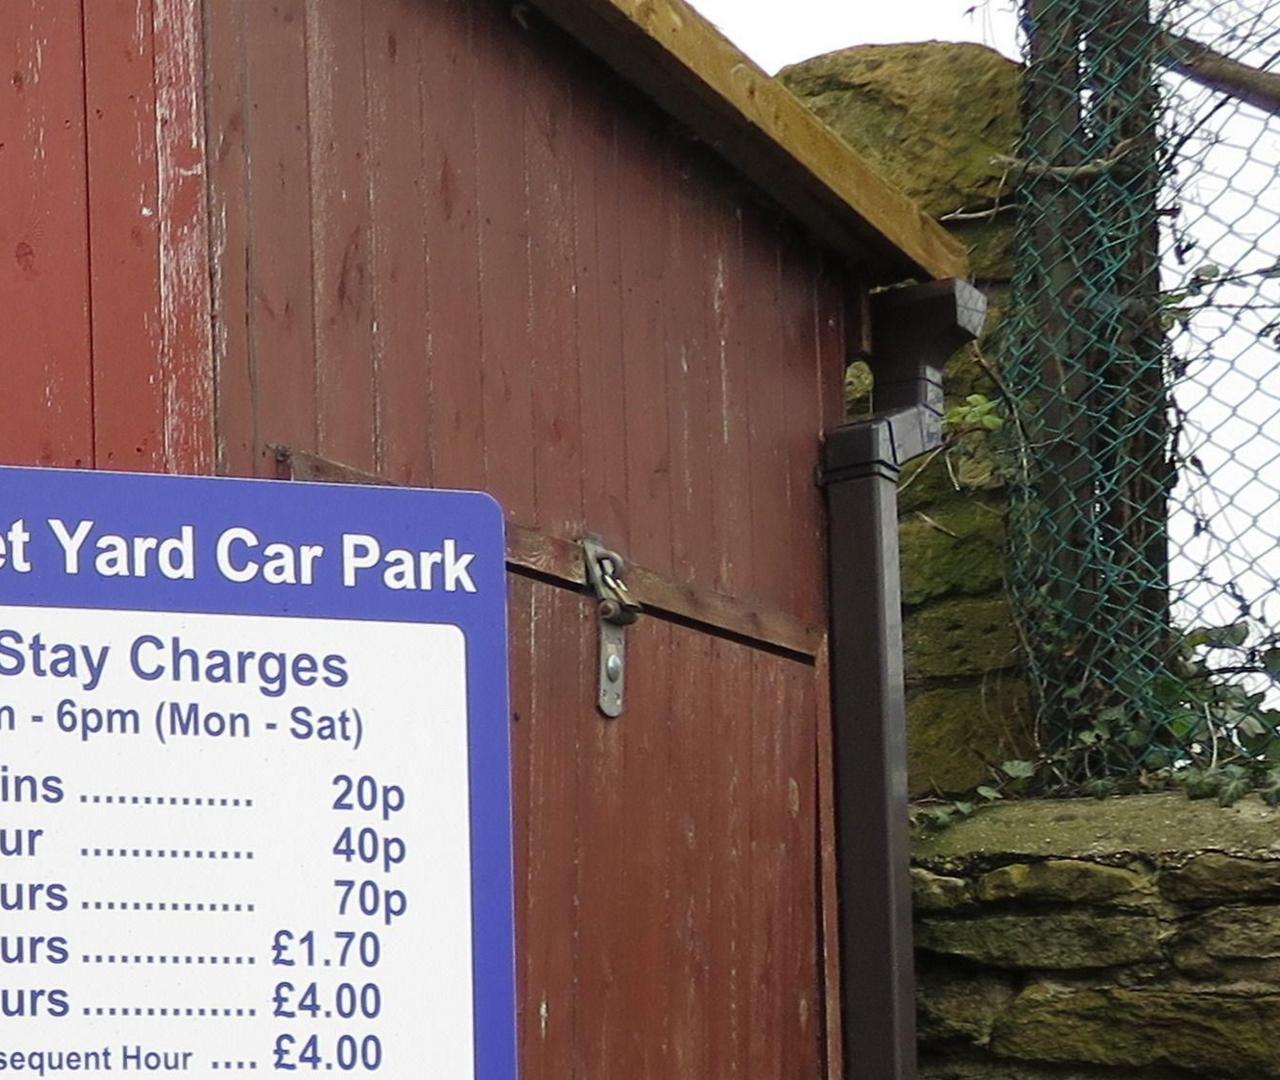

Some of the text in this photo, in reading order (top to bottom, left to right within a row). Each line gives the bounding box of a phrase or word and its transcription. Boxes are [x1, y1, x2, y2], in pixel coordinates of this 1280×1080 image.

[47, 519, 193, 579] Yard
[216, 527, 323, 584] Car
[342, 534, 476, 592] Park
[130, 634, 348, 697] Charges
[56, 698, 139, 741] 6pm
[155, 701, 249, 744] (Mon
[290, 706, 362, 750] Sat)
[332, 774, 404, 820] 20p
[332, 826, 405, 872] 40p
[334, 879, 407, 925] 70p
[271, 929, 380, 967] £1.70
[272, 981, 381, 1018] £4.00
[122, 1045, 192, 1070] Hour
[273, 1033, 381, 1070] £4.00
